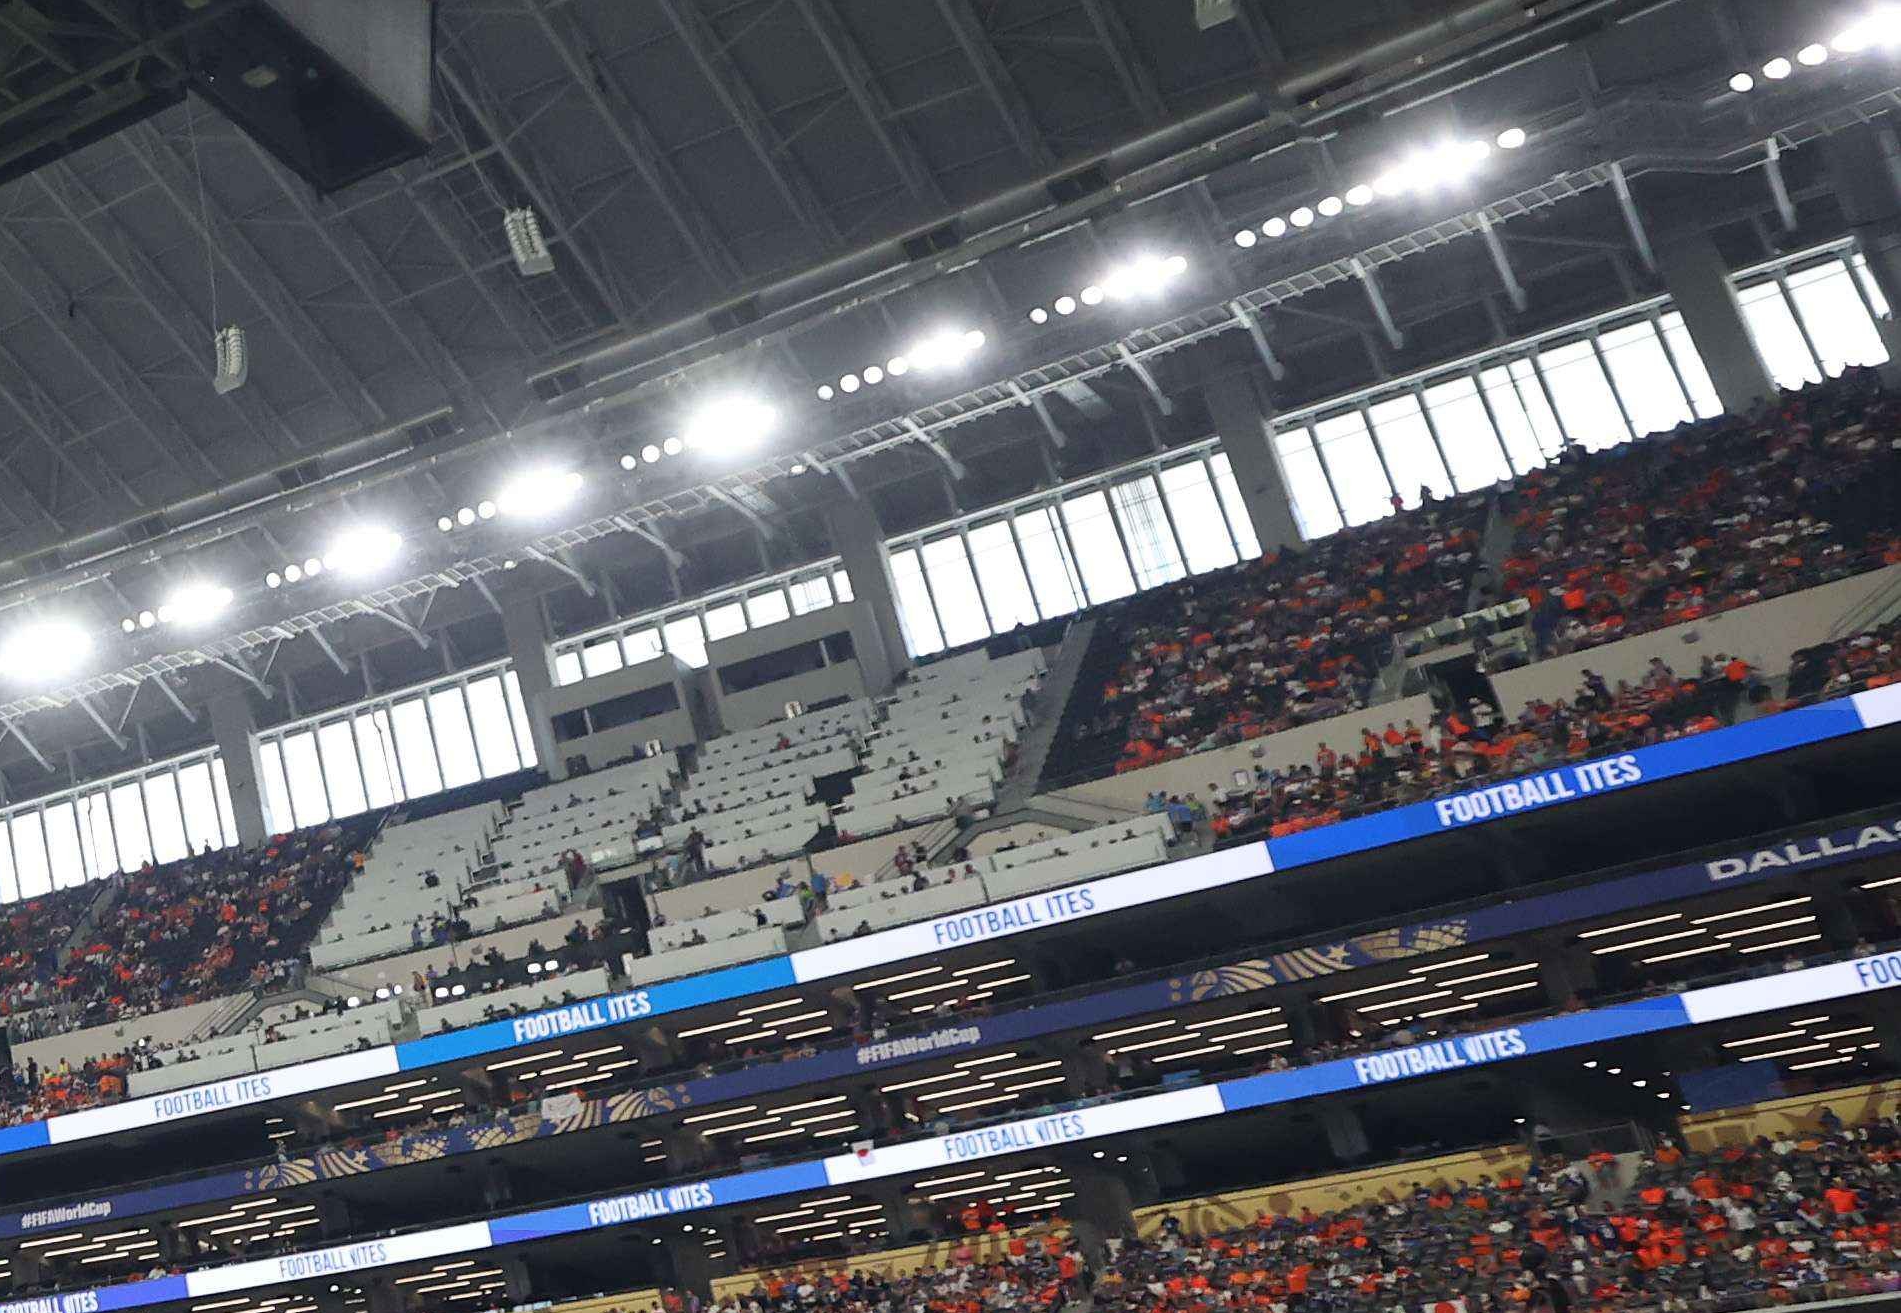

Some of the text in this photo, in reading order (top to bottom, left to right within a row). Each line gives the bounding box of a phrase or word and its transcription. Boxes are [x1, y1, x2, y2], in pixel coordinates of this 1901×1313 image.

[1435, 771, 1573, 828] FOOTBALL
[934, 900, 1042, 946] FOOTBALL
[512, 1003, 605, 1043] FOOTBALL
[857, 1026, 981, 1064] #FIFAWorldCup
[1353, 1041, 1465, 1084] FOOTBALL
[154, 1083, 231, 1119] FOOTBALL
[944, 1122, 1034, 1161] FOOTBALL
[21, 1201, 111, 1229] #FIFAWorldCup
[588, 1193, 666, 1225] FOOTBALL
[279, 1251, 345, 1278] FOOTBALL
